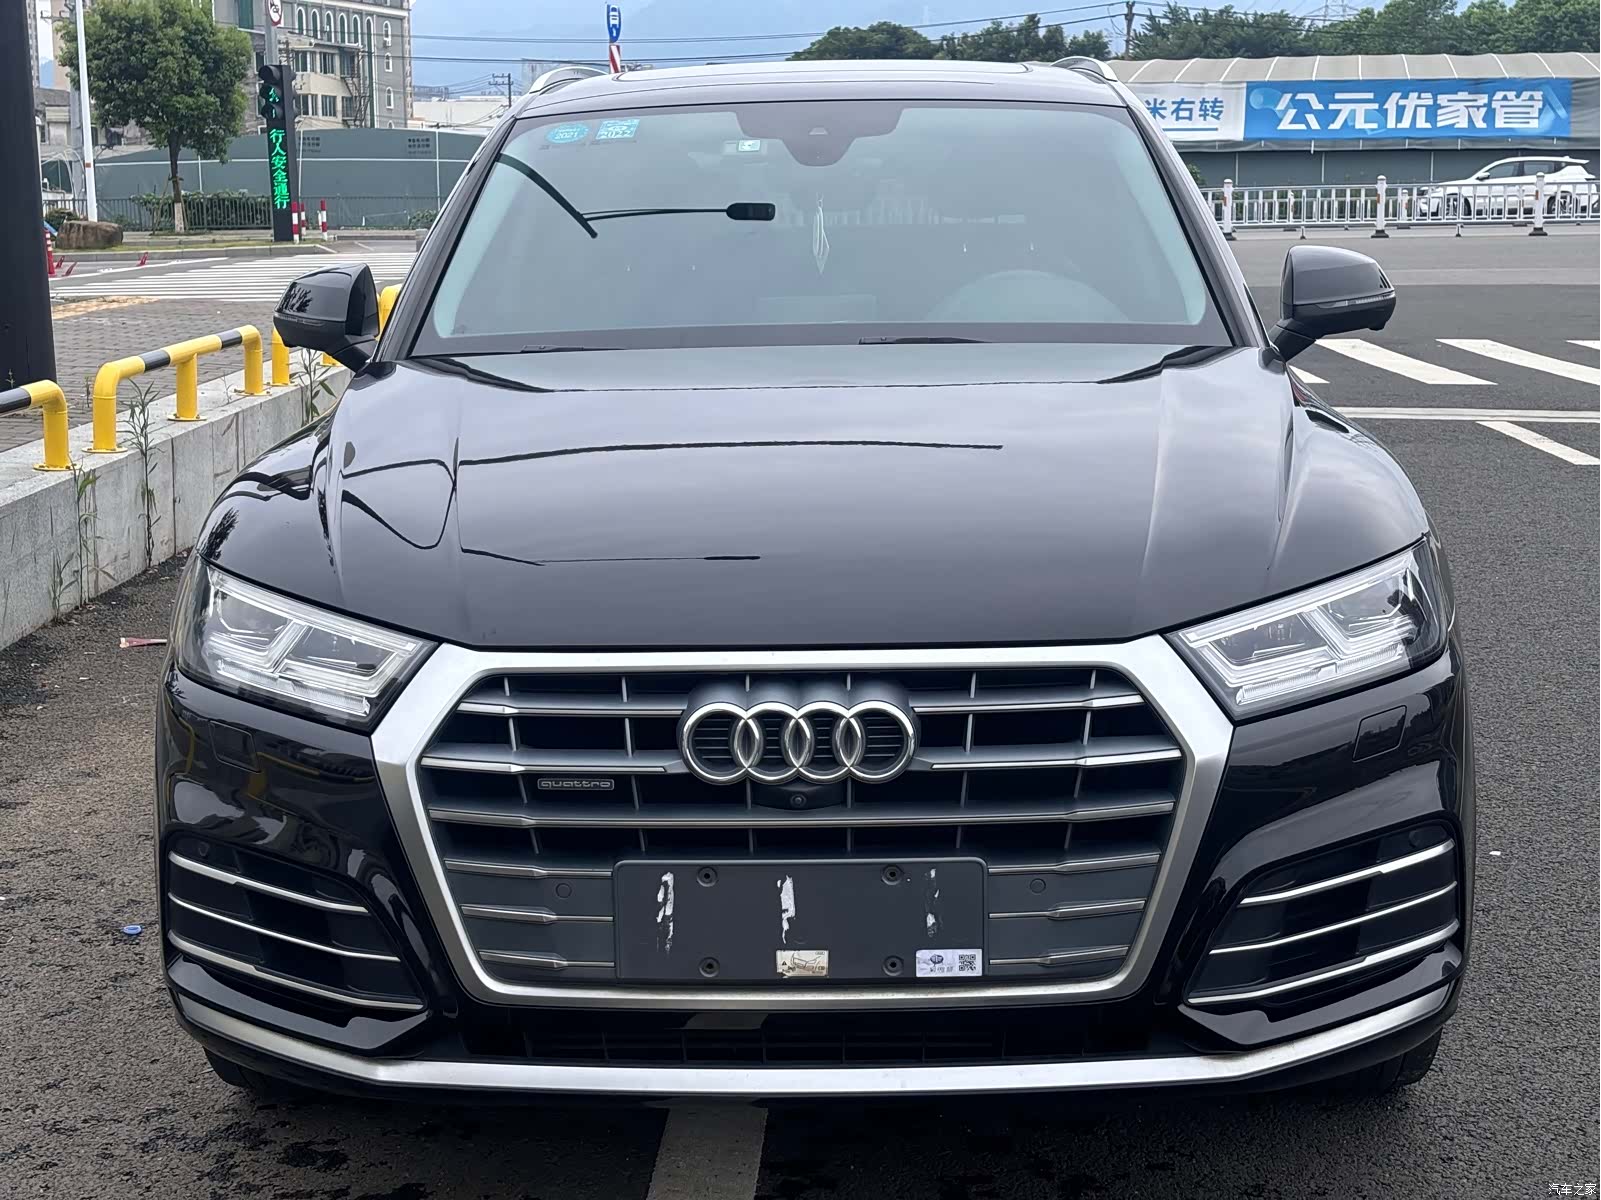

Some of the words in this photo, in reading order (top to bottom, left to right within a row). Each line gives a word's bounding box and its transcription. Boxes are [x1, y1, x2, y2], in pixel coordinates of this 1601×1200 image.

[1144, 97, 1225, 122] 米右转
[1275, 90, 1546, 131] 公元优家管
[269, 128, 291, 209] 行人安全通行
[541, 780, 611, 789] quattro
